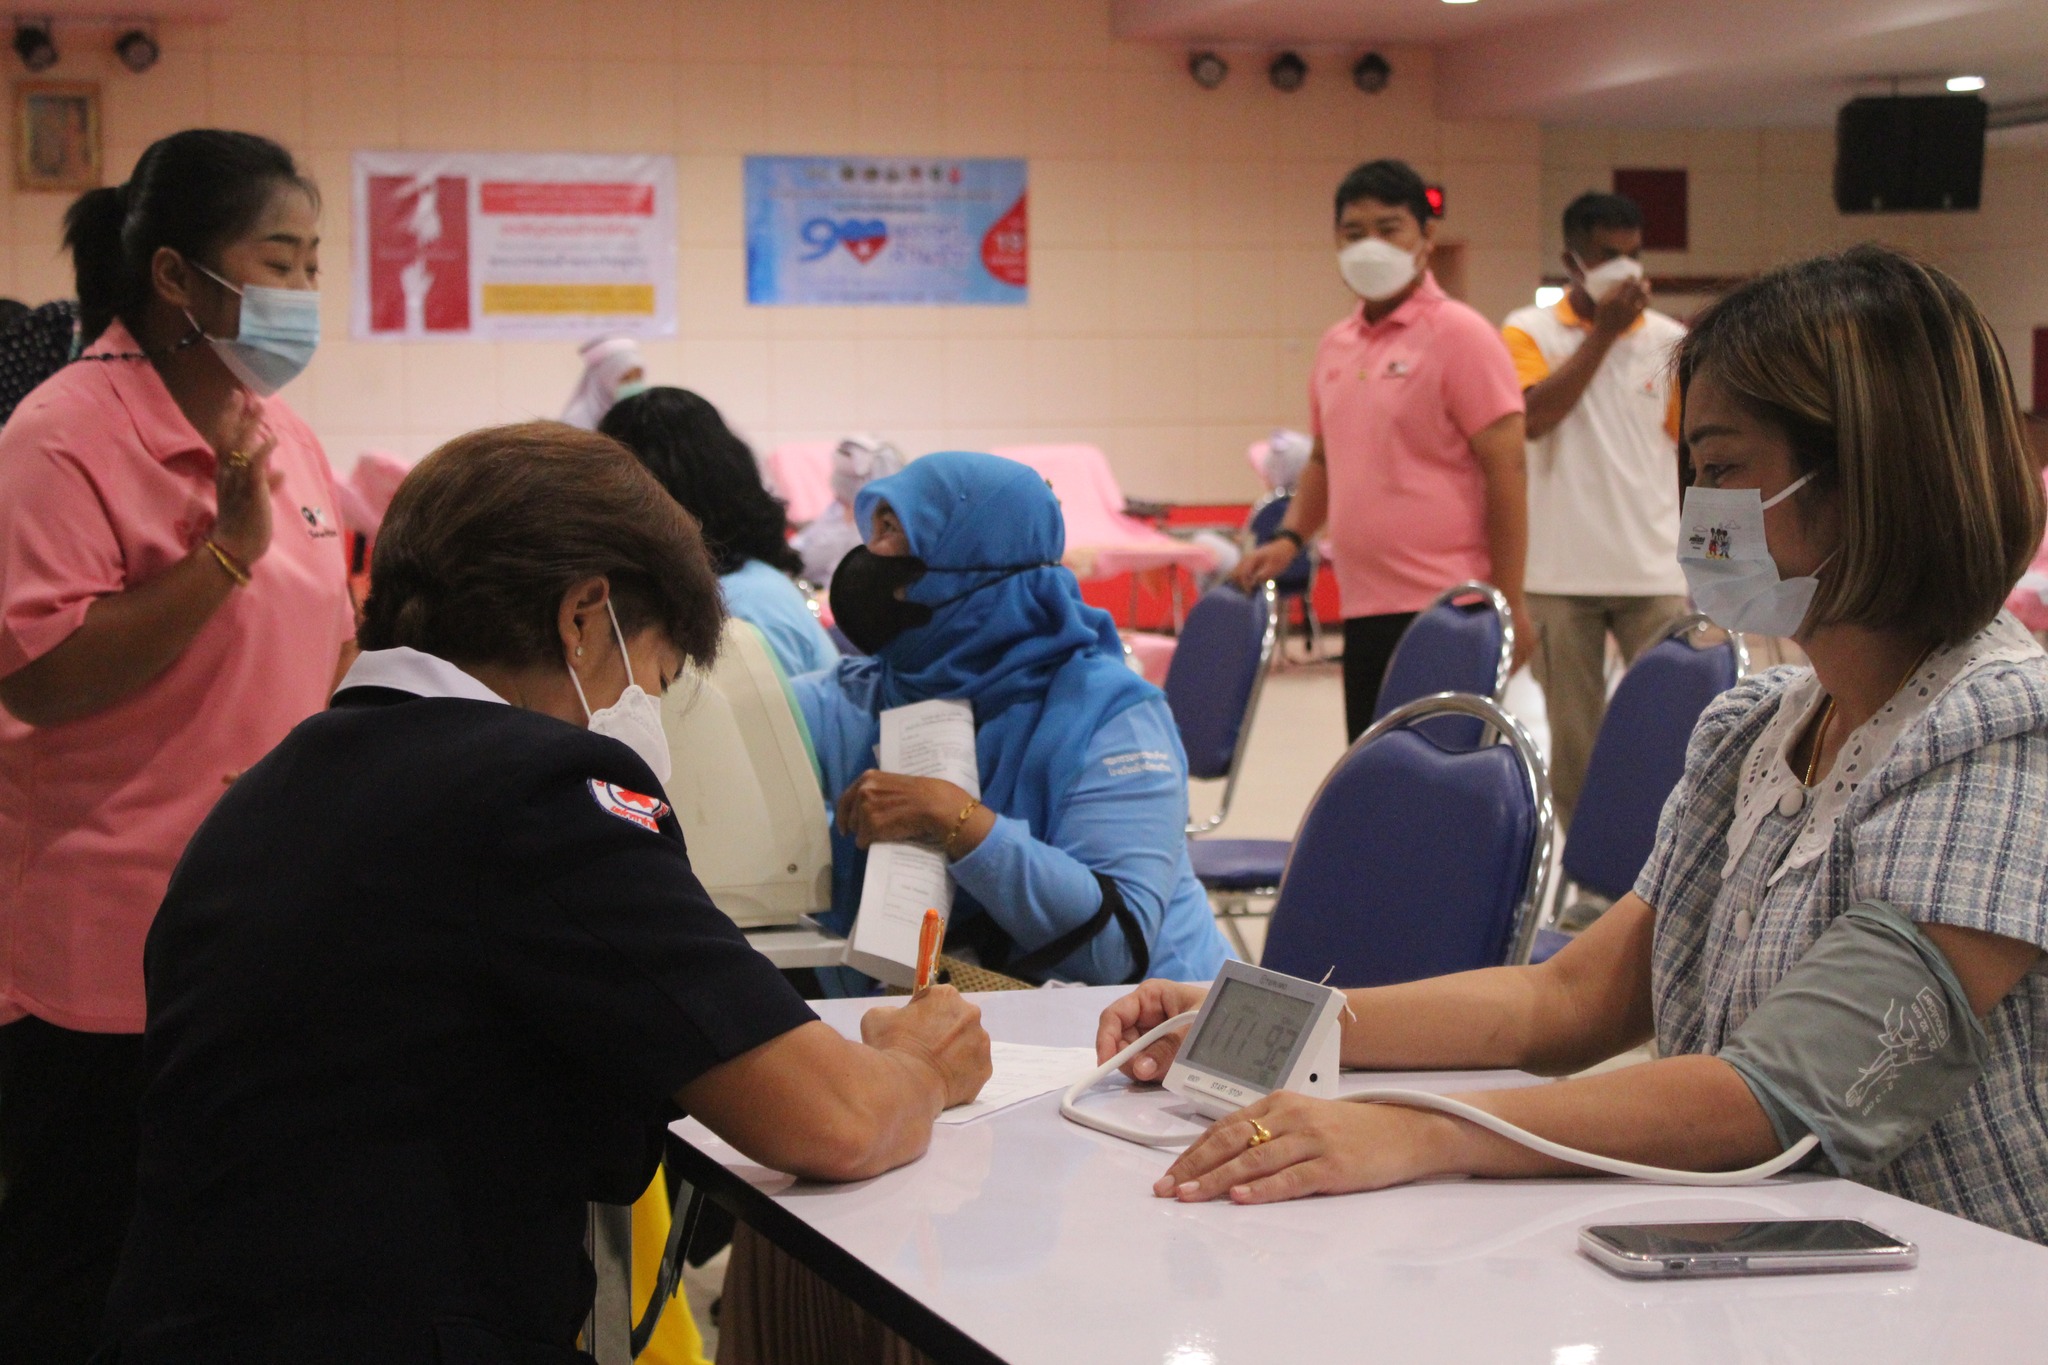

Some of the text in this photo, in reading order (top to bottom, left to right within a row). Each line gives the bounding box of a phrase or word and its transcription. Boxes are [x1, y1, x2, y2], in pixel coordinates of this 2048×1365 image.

[1910, 1002, 1922, 1019] cm
[1922, 994, 1947, 1040] shoulder
[1919, 1018, 1930, 1033] 32
[1928, 1039, 1938, 1052] 22
